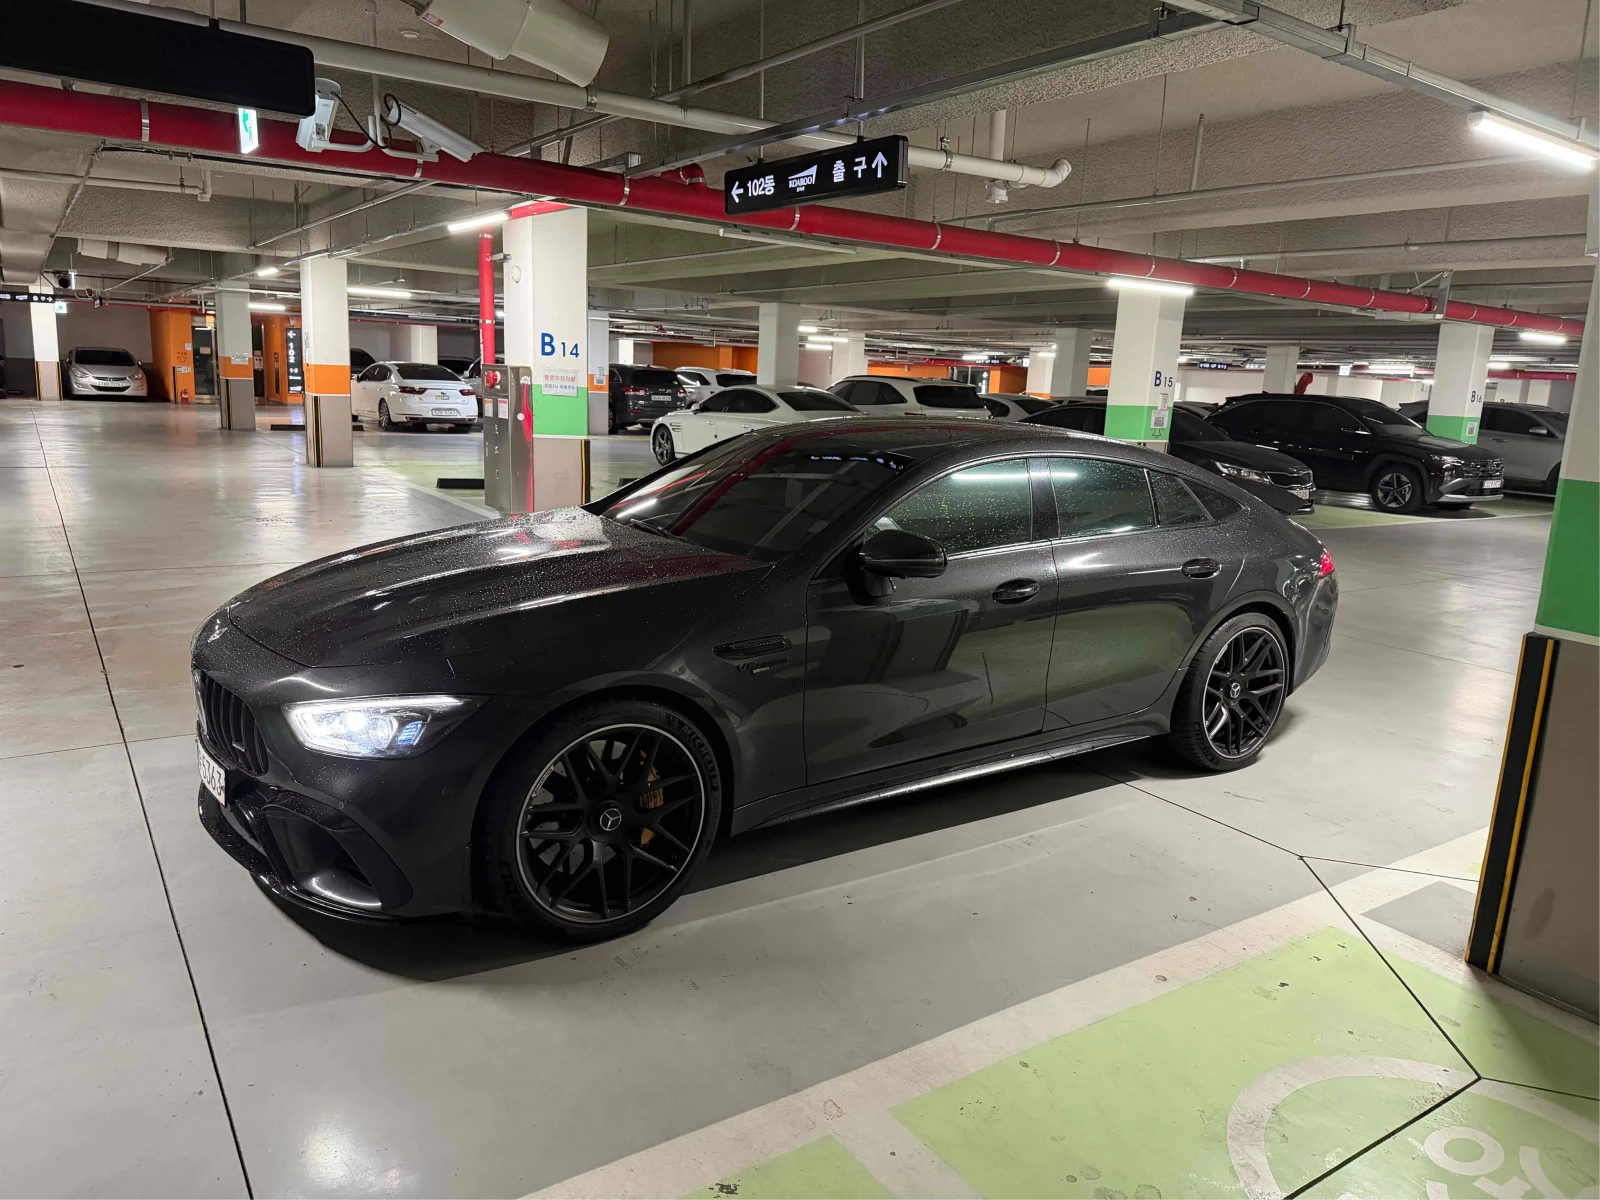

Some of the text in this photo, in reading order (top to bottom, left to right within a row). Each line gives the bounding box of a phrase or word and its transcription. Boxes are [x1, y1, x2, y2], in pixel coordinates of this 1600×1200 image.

[747, 174, 775, 197] 102동
[288, 342, 296, 363] 102
[541, 332, 580, 358] B 14
[1154, 371, 1173, 388] B 15
[1470, 390, 1476, 403] B
[681, 724, 720, 789] MICHELIN
